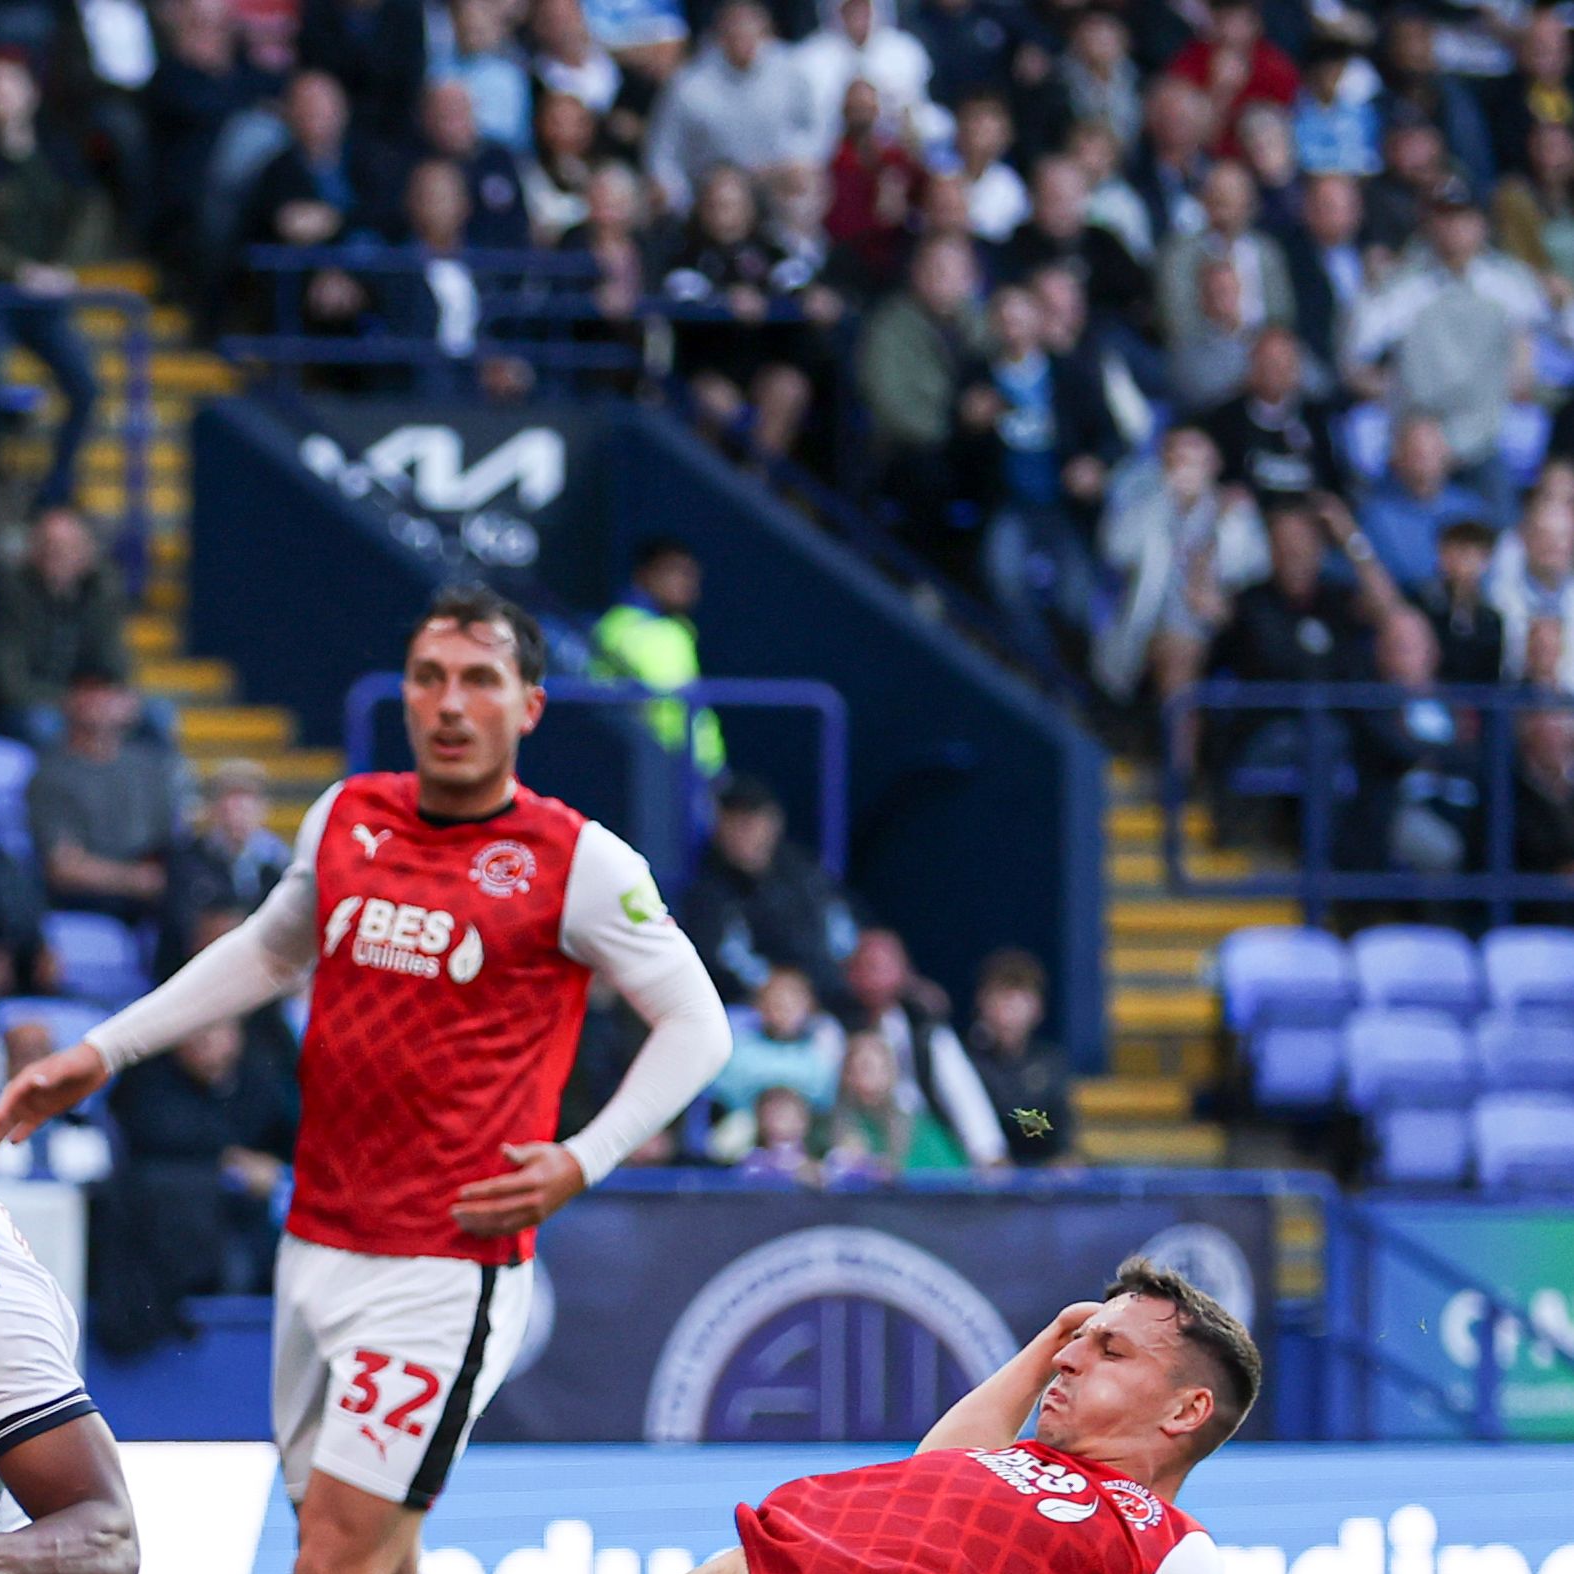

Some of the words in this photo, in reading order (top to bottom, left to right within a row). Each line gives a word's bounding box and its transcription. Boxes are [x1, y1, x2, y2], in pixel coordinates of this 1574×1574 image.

[358, 897, 455, 955] BES
[353, 937, 440, 979] Utilities
[340, 1349, 439, 1436] 32
